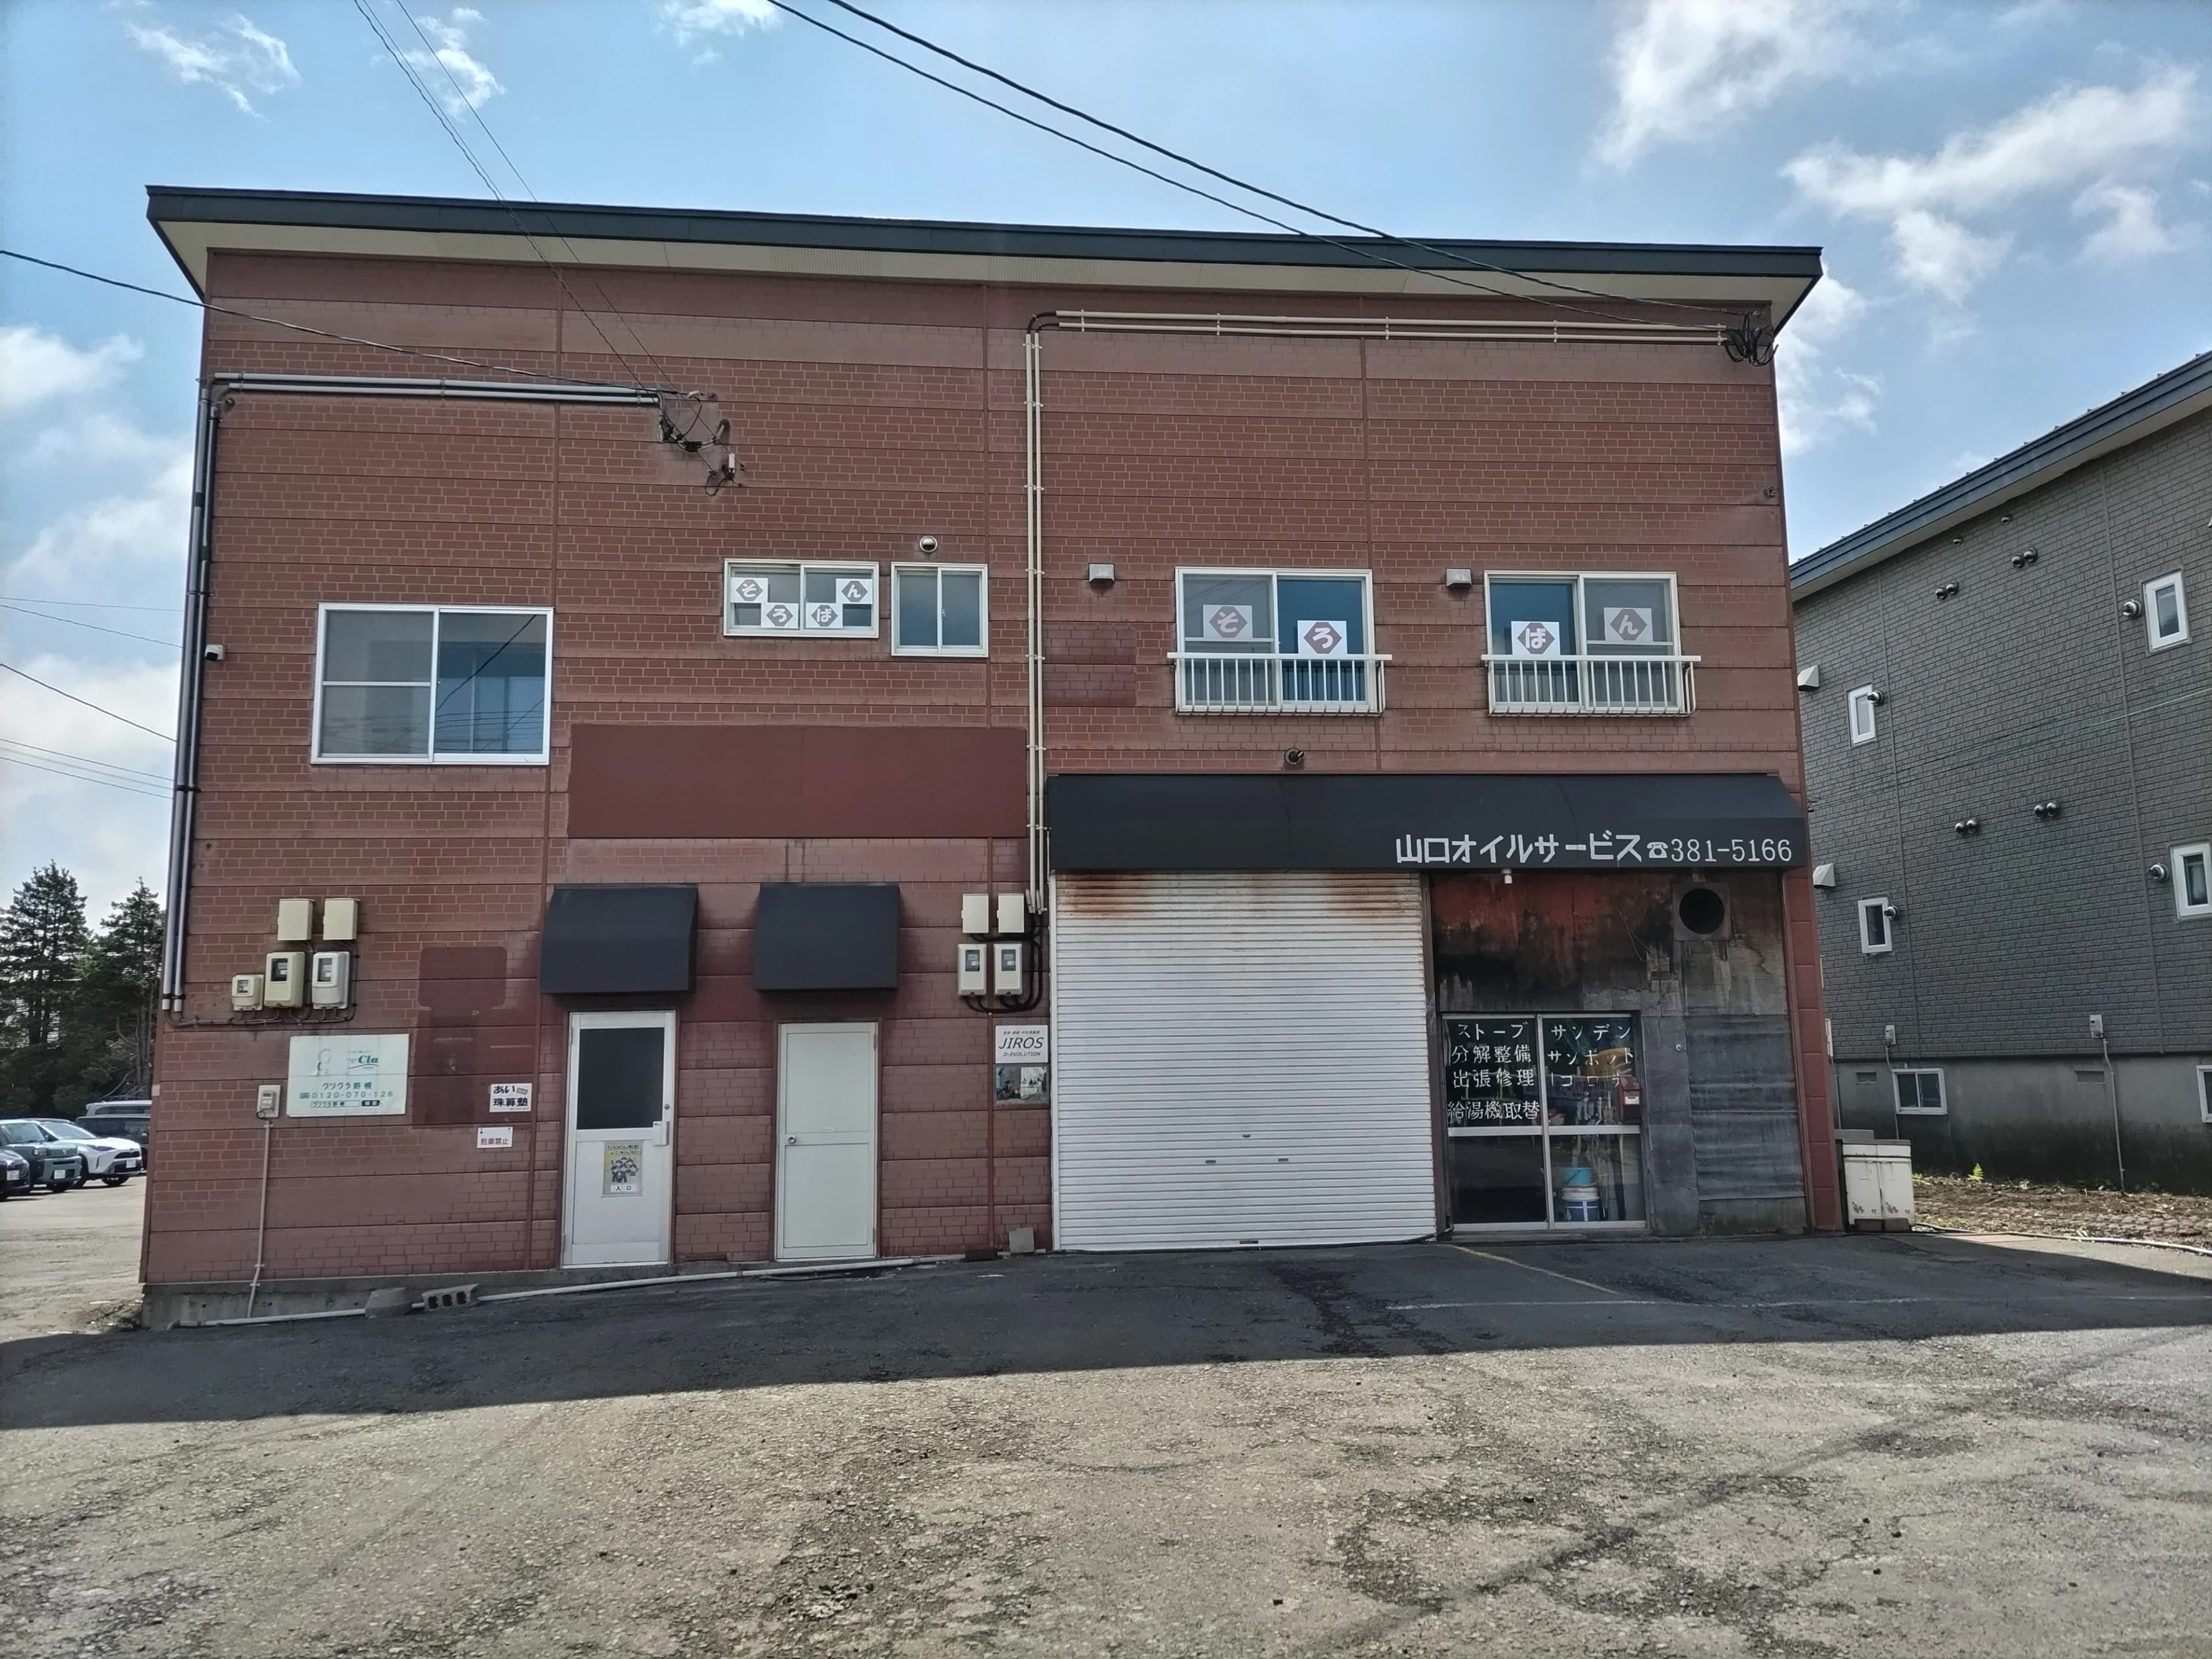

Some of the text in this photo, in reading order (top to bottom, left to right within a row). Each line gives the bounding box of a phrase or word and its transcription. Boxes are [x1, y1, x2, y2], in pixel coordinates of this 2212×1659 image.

[1395, 830, 1793, 863] 山口オイルサービス 381-5166
[1458, 1021, 1528, 1040] ストーブ
[1551, 1024, 1631, 1041] サンデン
[998, 1037, 1044, 1050] JIROS
[1451, 1044, 1531, 1064] 分解整備
[1547, 1047, 1634, 1066] サンポット
[1453, 1068, 1535, 1088] 出張修理
[311, 1091, 393, 1099] 0120-070-126
[493, 1085, 516, 1094] あい
[493, 1097, 529, 1107] 珠算塾
[1447, 1100, 1540, 1120] 給湯機取替
